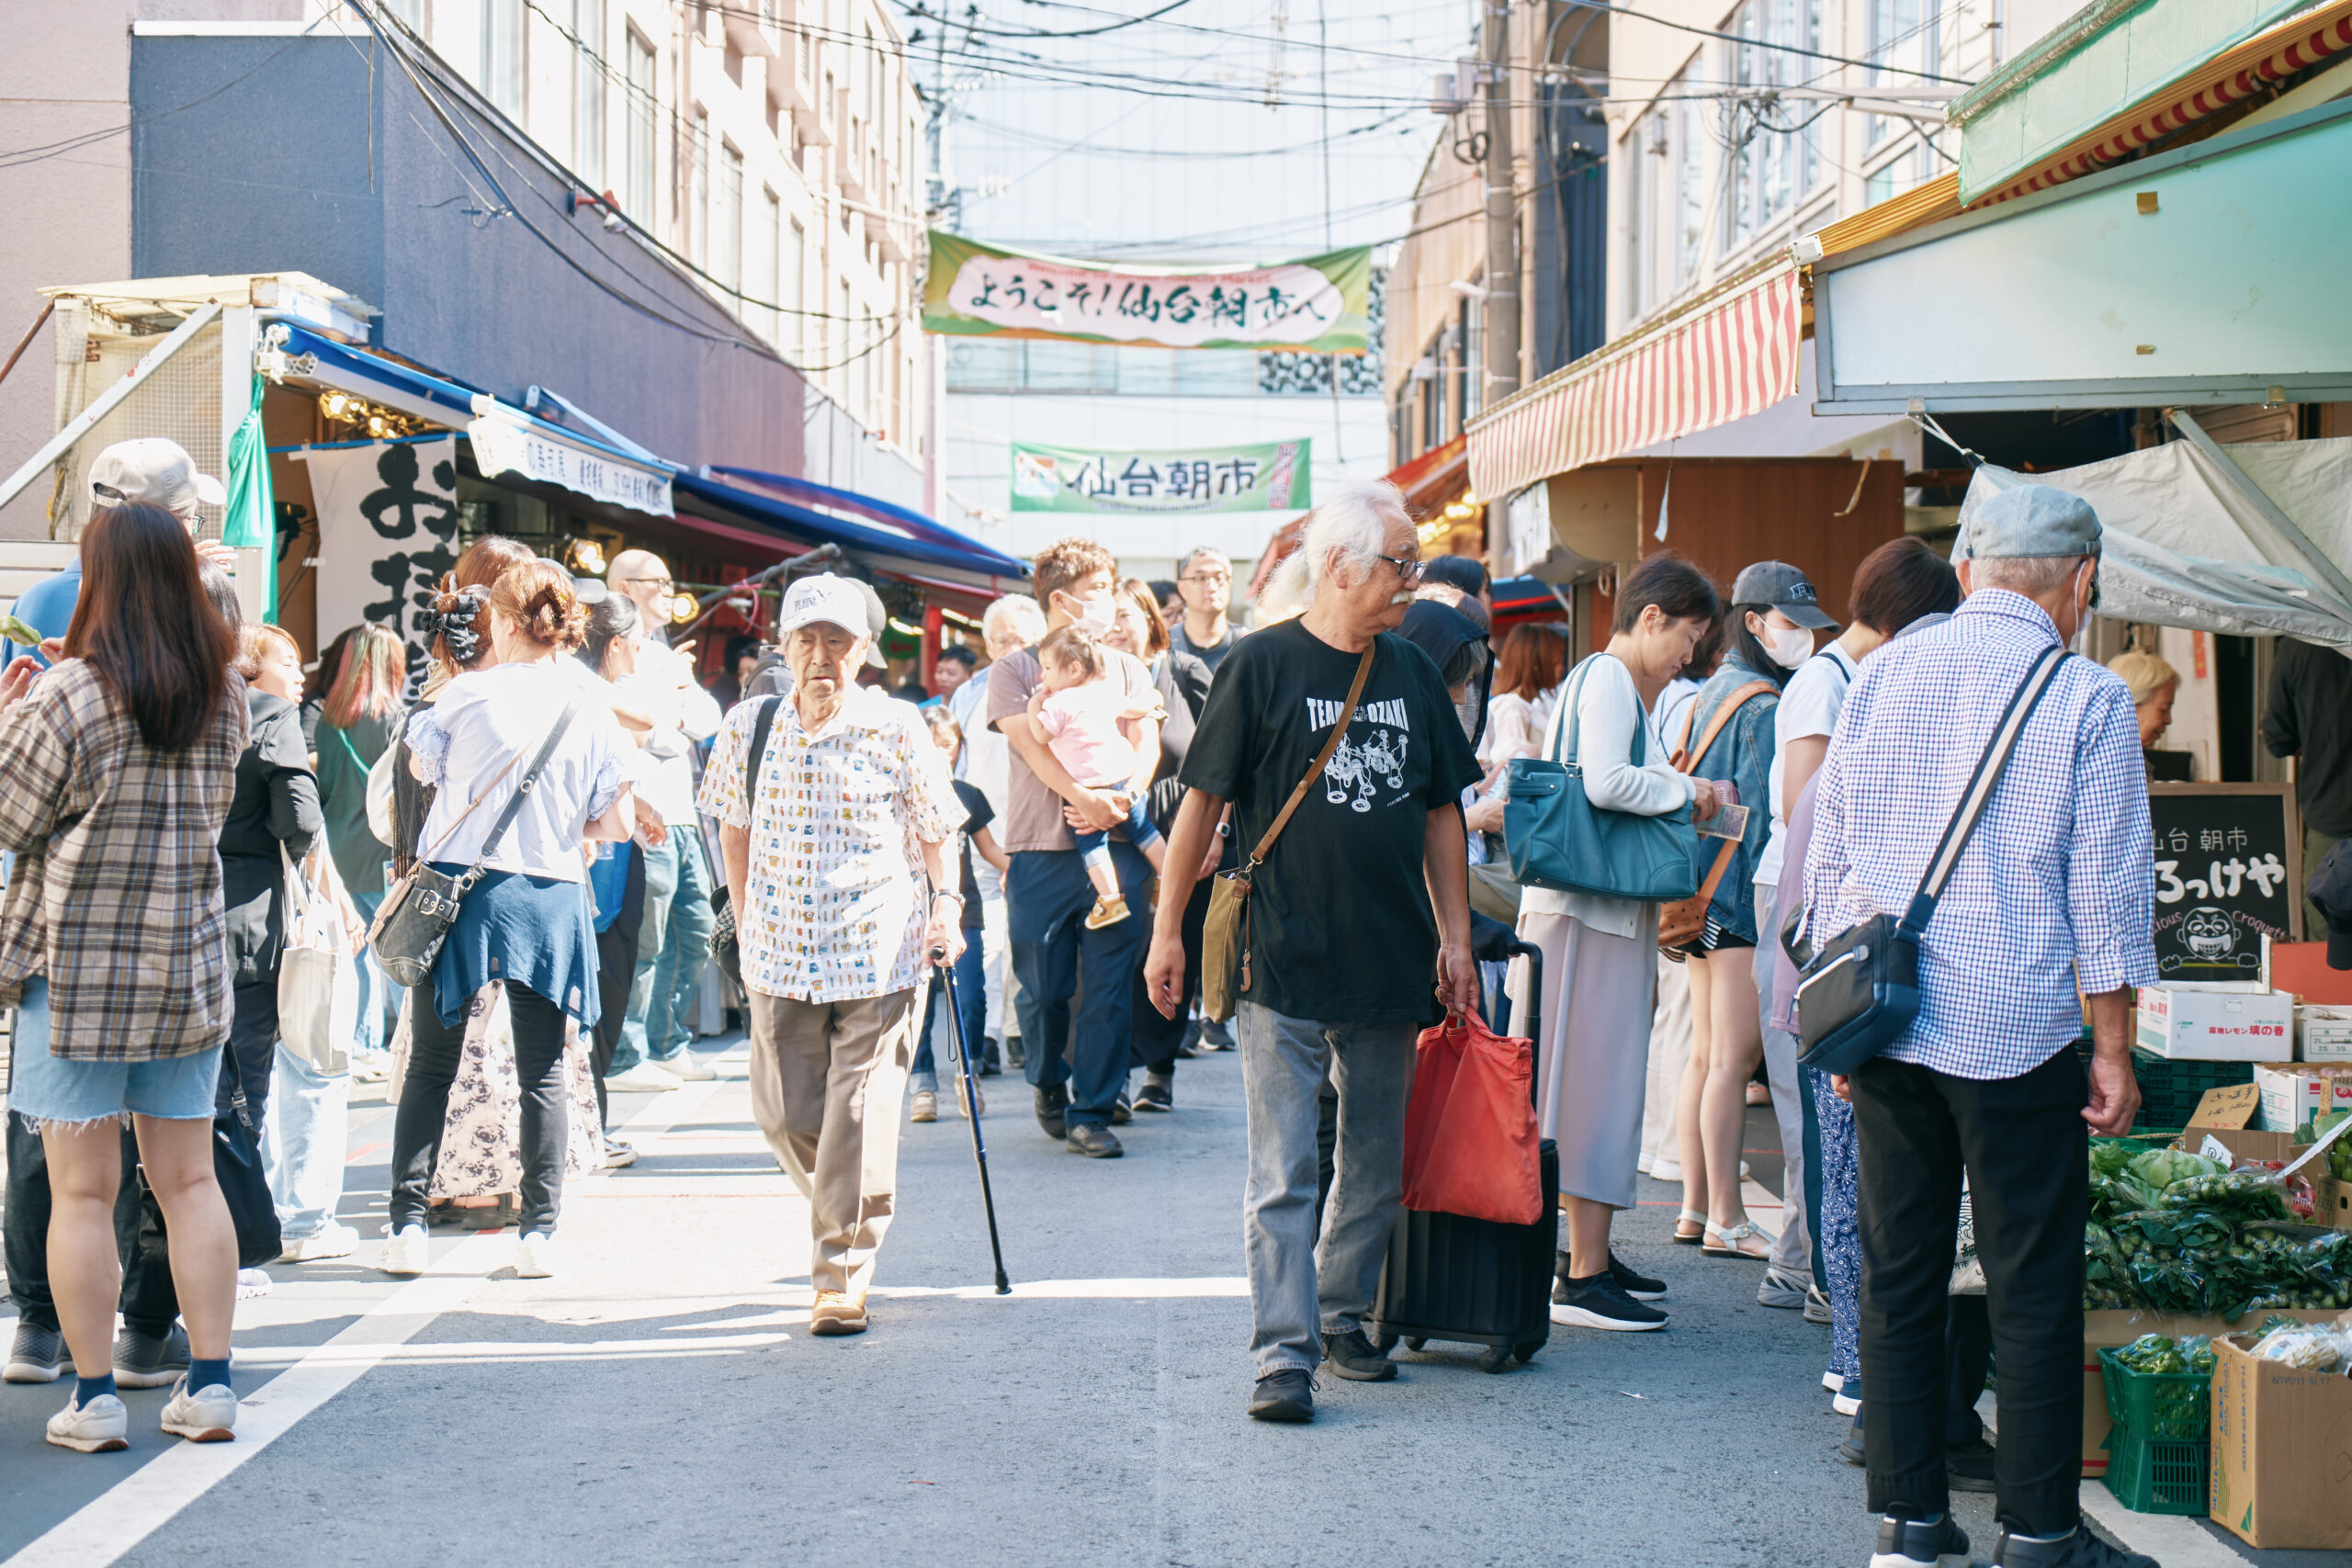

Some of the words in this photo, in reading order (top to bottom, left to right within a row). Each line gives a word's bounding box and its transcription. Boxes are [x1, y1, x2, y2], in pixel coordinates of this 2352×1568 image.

[1067, 455, 1257, 499] 仙台朝市
[1367, 697, 1409, 732] OZAKI
[2154, 852, 2286, 904] ろっけや
